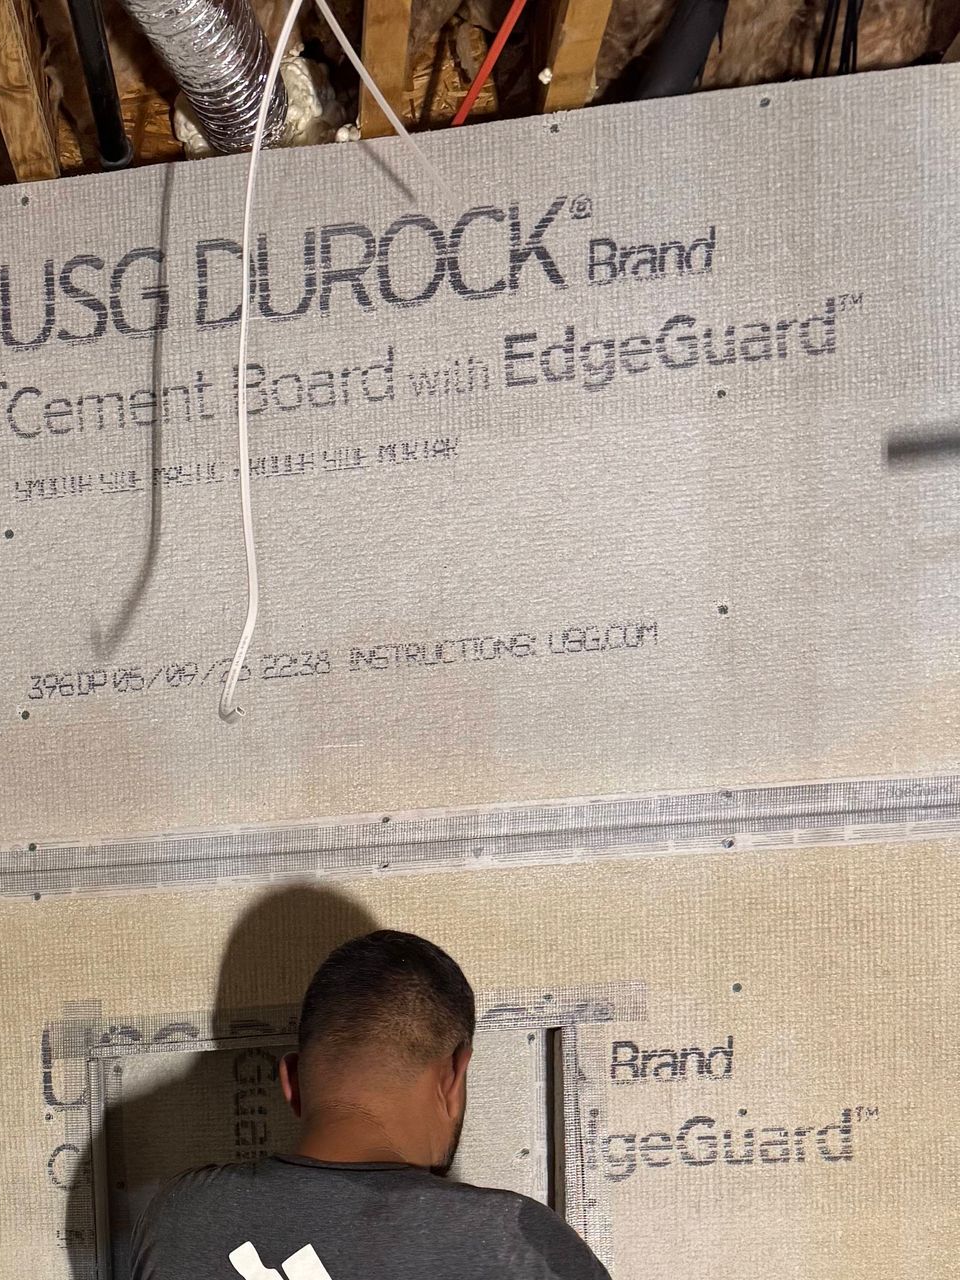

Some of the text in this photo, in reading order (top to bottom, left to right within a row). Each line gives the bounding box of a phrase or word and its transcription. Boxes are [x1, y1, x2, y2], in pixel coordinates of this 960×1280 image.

[0, 246, 170, 351] USG
[587, 225, 717, 286] Brand
[7, 370, 214, 439] Cement
[233, 345, 396, 416] Board
[411, 355, 490, 397] with
[611, 1035, 735, 1084] Brand
